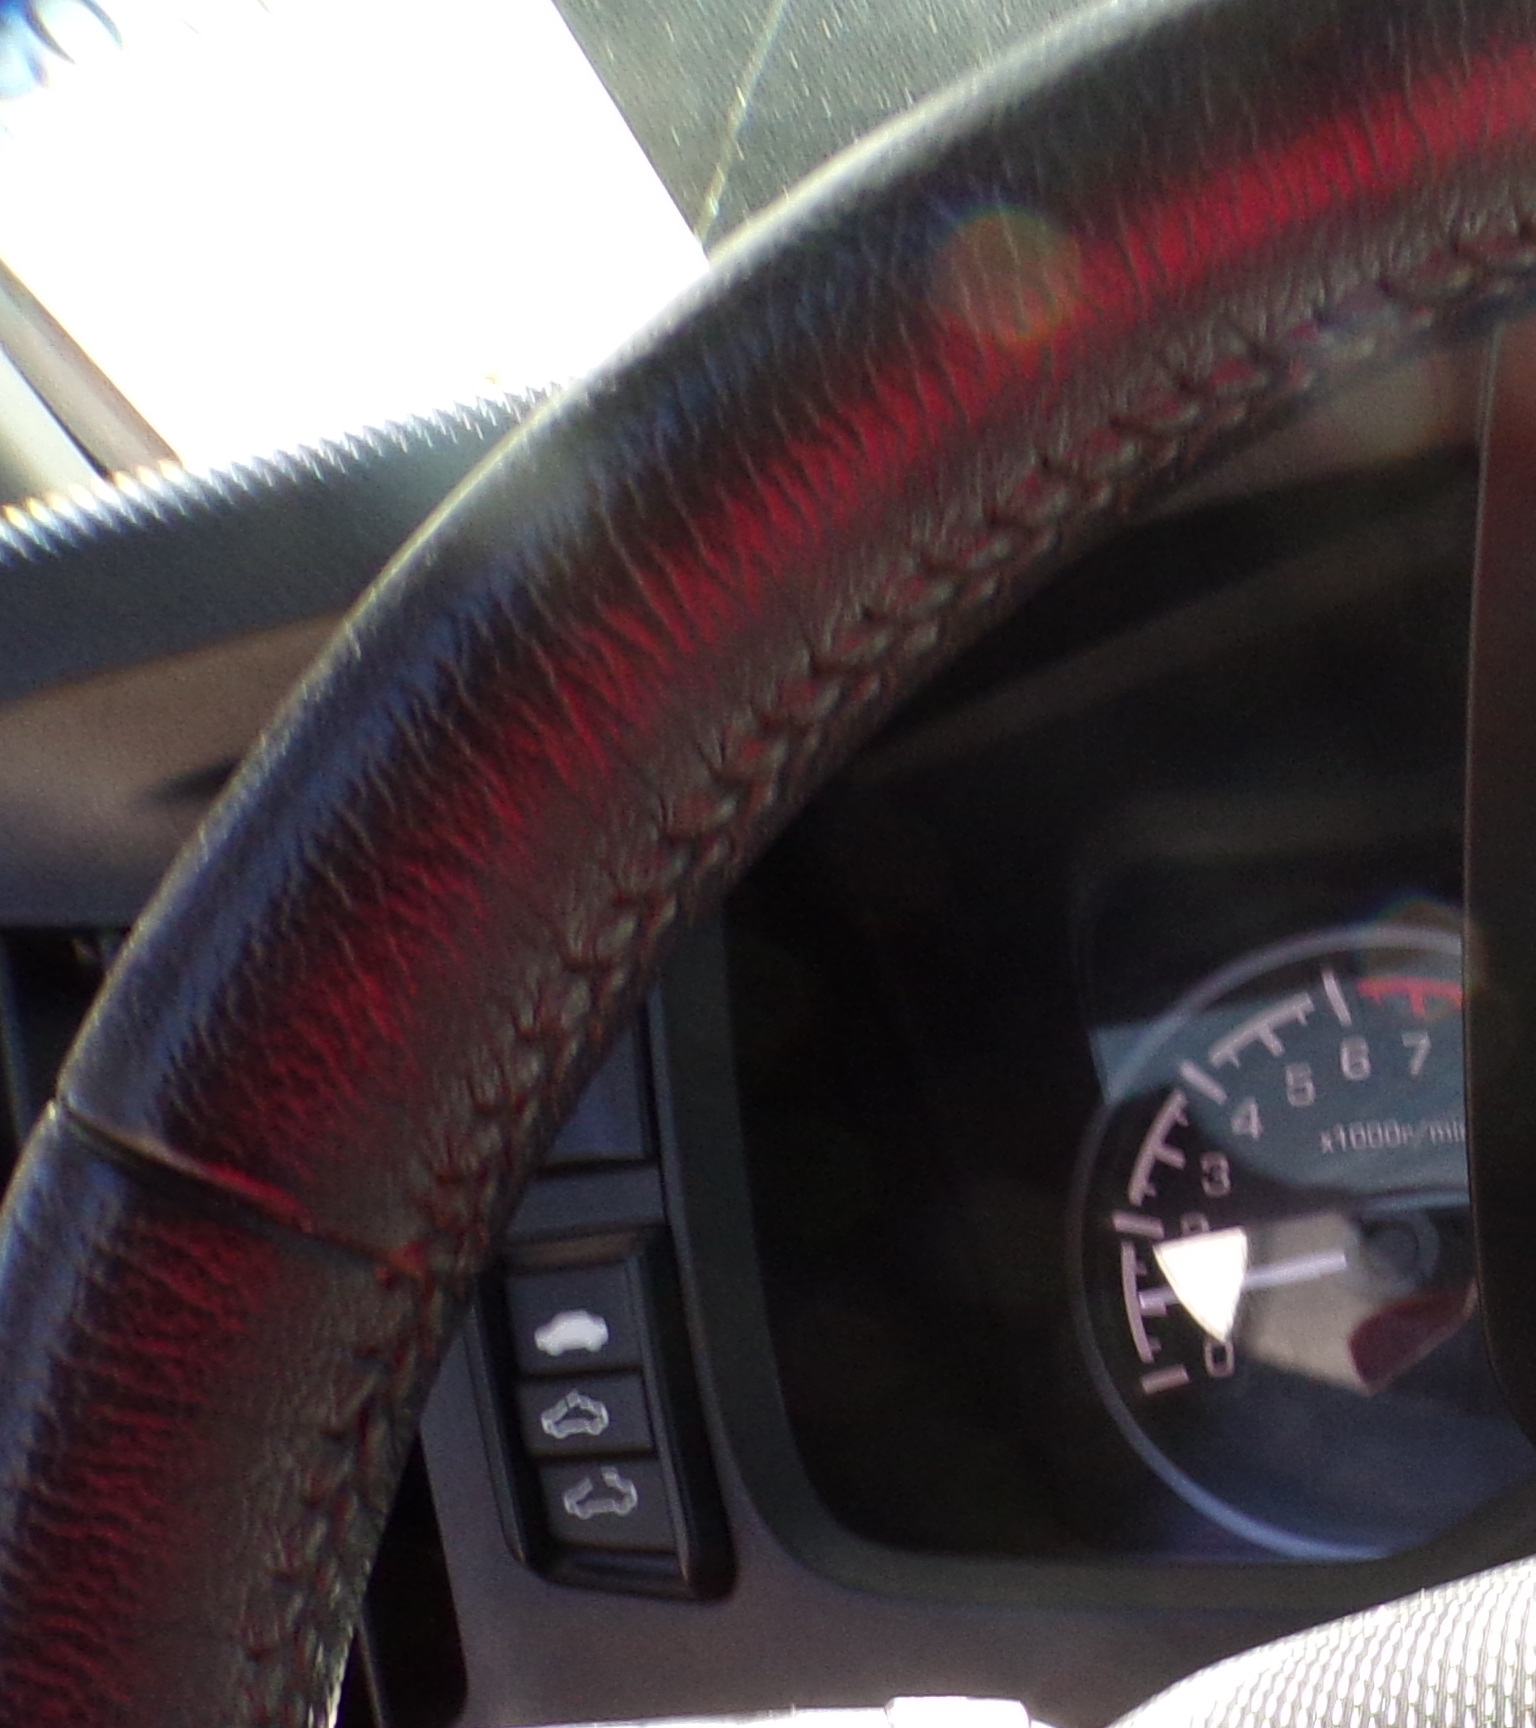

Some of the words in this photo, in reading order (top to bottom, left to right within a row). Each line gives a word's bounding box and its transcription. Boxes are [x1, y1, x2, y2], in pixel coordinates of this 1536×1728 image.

[1338, 1036, 1372, 1081] 6
[1402, 1030, 1432, 1076] 7
[1284, 1062, 1316, 1107] 5
[1230, 1099, 1264, 1141] 4
[1200, 1151, 1232, 1198] 3
